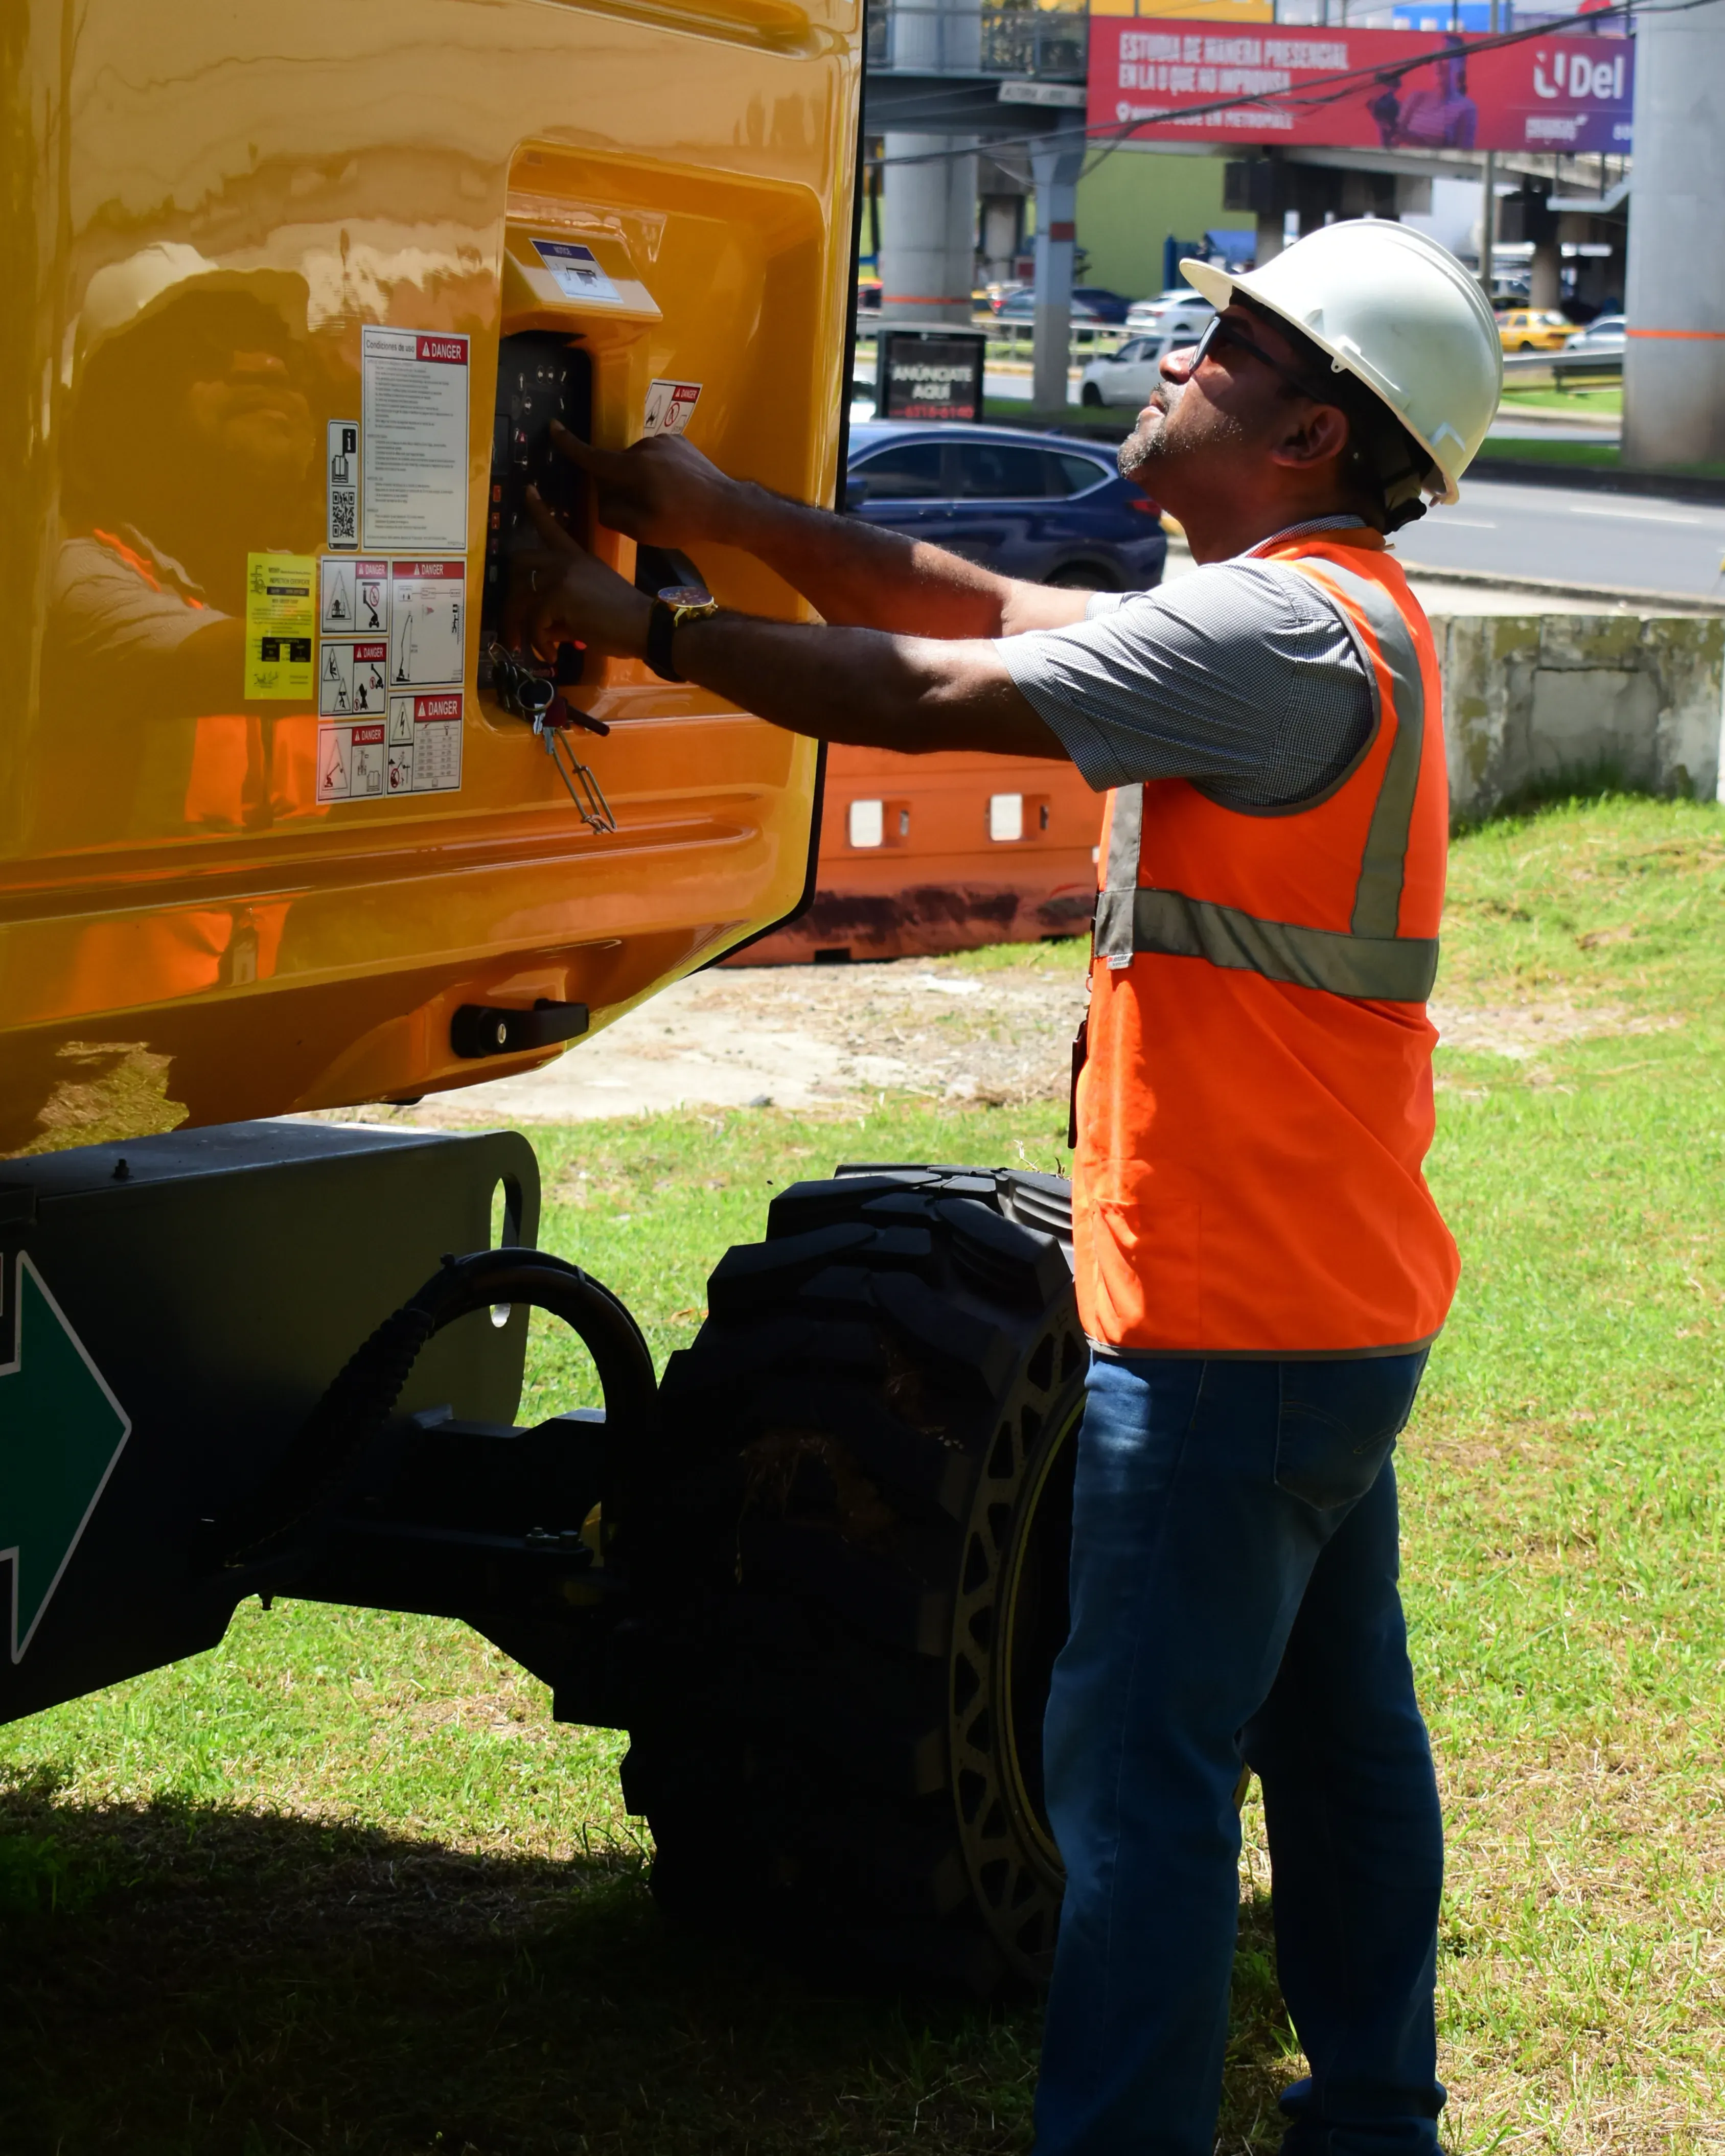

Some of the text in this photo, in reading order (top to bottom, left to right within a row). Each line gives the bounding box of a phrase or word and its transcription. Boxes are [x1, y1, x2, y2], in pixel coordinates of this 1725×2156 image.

[1183, 35, 1202, 63] DE
[1203, 36, 1262, 66] MANERA
[1264, 39, 1349, 70] PRESENCIAL
[366, 340, 398, 351] Condiciones
[398, 343, 405, 352] de
[431, 343, 462, 359] DANGER
[681, 389, 697, 399] DANGER
[365, 564, 385, 575] DANGER
[422, 564, 444, 575] DANGER
[363, 647, 383, 658] DANGER
[428, 701, 458, 715] DANGER
[361, 729, 382, 740] DANGER
